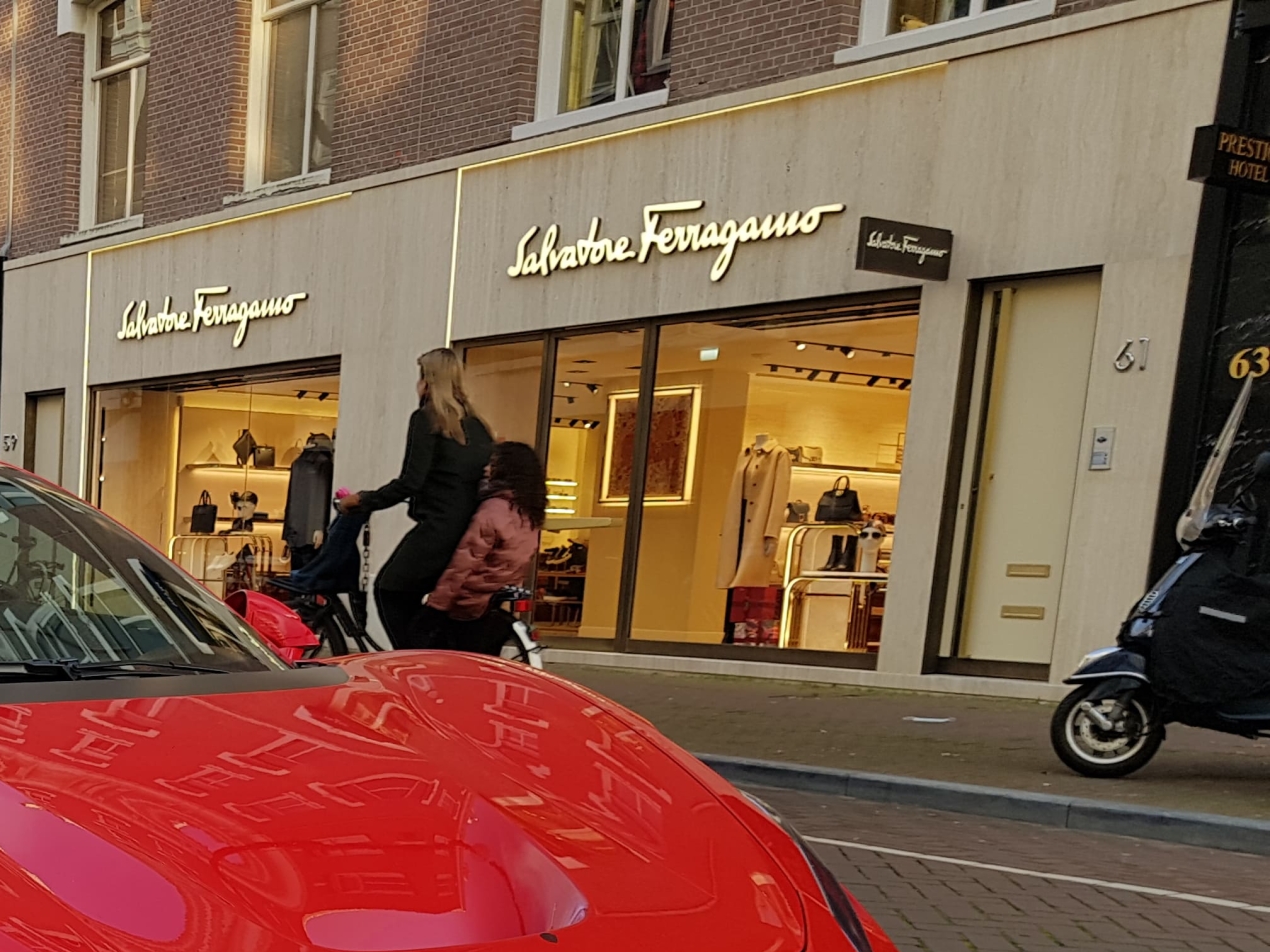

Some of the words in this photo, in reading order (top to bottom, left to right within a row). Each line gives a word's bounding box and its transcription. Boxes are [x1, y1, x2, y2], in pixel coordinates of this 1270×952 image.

[1227, 159, 1270, 183] HOTEL
[507, 216, 635, 277] Salvatore
[637, 200, 846, 282] Ferragamo
[117, 296, 192, 340] Salvatore
[192, 286, 309, 348] Ferragamo
[1228, 346, 1270, 380] 63
[3, 433, 19, 452] 59
